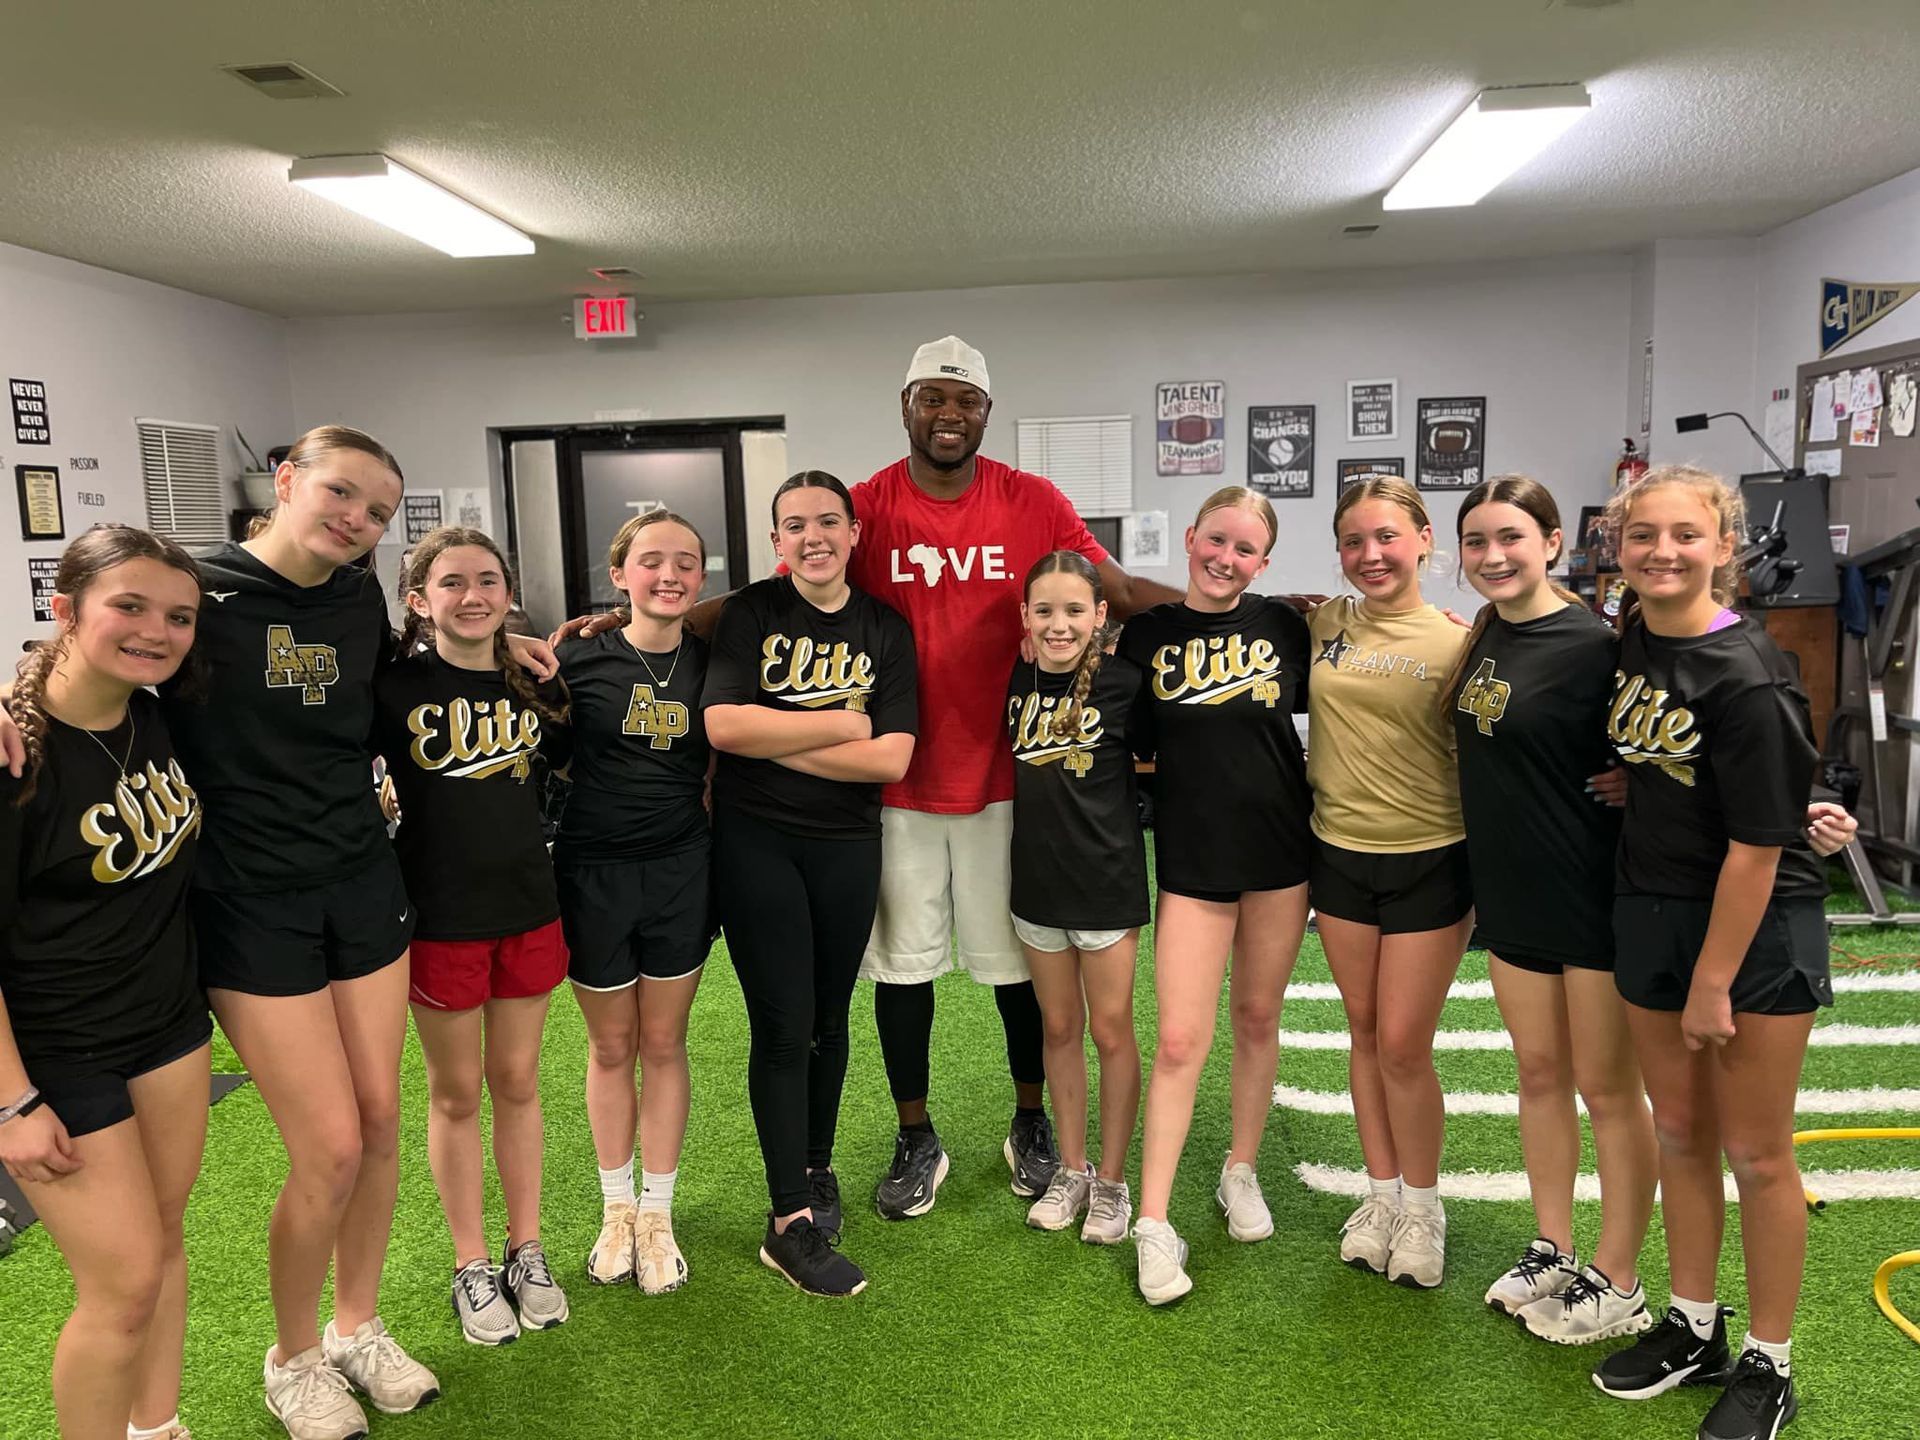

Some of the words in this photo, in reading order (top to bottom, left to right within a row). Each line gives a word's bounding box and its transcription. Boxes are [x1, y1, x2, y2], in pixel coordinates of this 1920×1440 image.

[584, 299, 627, 333] EXIT
[12, 382, 44, 398] NEVER
[1160, 385, 1221, 405] TALENT
[17, 399, 44, 412] NEVER
[20, 414, 44, 426] NEVER
[1357, 411, 1387, 422] SHOW
[18, 428, 38, 441] GIVE
[38, 429, 48, 441] UP
[1252, 423, 1309, 439] CHANCES
[1358, 423, 1387, 434] THEM
[1162, 443, 1220, 458] TEAMWORK
[69, 457, 99, 471] PASSION
[1279, 470, 1308, 486] YOU
[1463, 466, 1479, 486] US
[77, 491, 105, 507] FUELED
[408, 508, 439, 518] CARES
[35, 598, 52, 609] CHA
[265, 624, 340, 705] AP
[761, 633, 876, 692] Elite
[1152, 633, 1280, 701] Elite
[1322, 641, 1428, 680] ATLANTA
[1458, 657, 1512, 737] AP
[622, 683, 690, 751] AP
[1607, 669, 1702, 754] lite
[407, 697, 542, 771] Elite
[1063, 744, 1094, 778] AP
[80, 757, 198, 883] Elite
